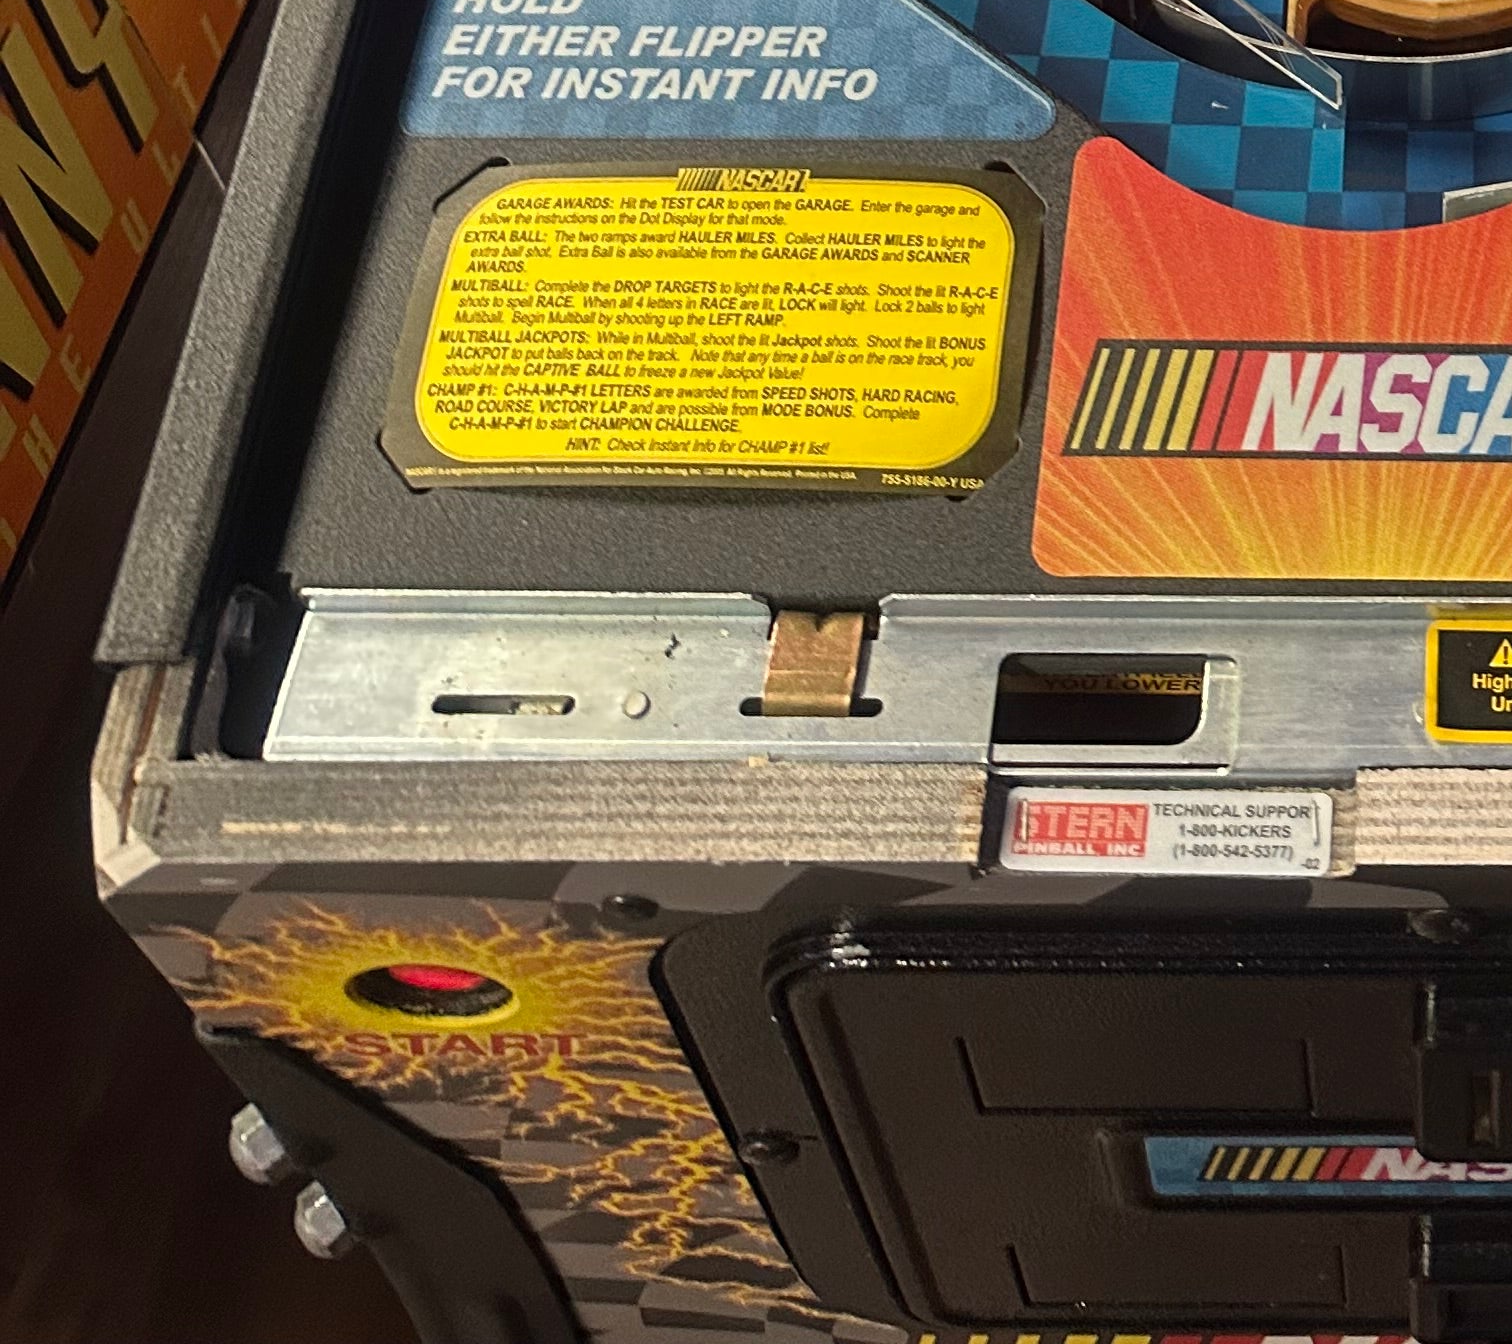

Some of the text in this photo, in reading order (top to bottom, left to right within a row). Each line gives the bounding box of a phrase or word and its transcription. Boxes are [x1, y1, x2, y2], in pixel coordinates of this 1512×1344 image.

[442, 24, 828, 59] EITHER FLIPPER
[432, 66, 879, 102] FOR INSTANT INFO
[715, 169, 805, 192] NASCAR
[496, 198, 615, 210] GARAGE AWARDS:
[463, 230, 548, 243] EXTRA BALL:
[450, 280, 530, 293] MULTIBALL:
[438, 330, 590, 344] MULTIBALL JACKPOTS:
[427, 383, 476, 397] CHAMP
[1044, 678, 1202, 692] YOU LOWER
[1153, 803, 1319, 819] TECHNICAL SUPPOR
[1178, 823, 1292, 839] 1-800-KICKERS
[1107, 842, 1144, 857] INC
[1172, 843, 1294, 861] (1-800-542-5377)
[345, 1032, 589, 1059] START
